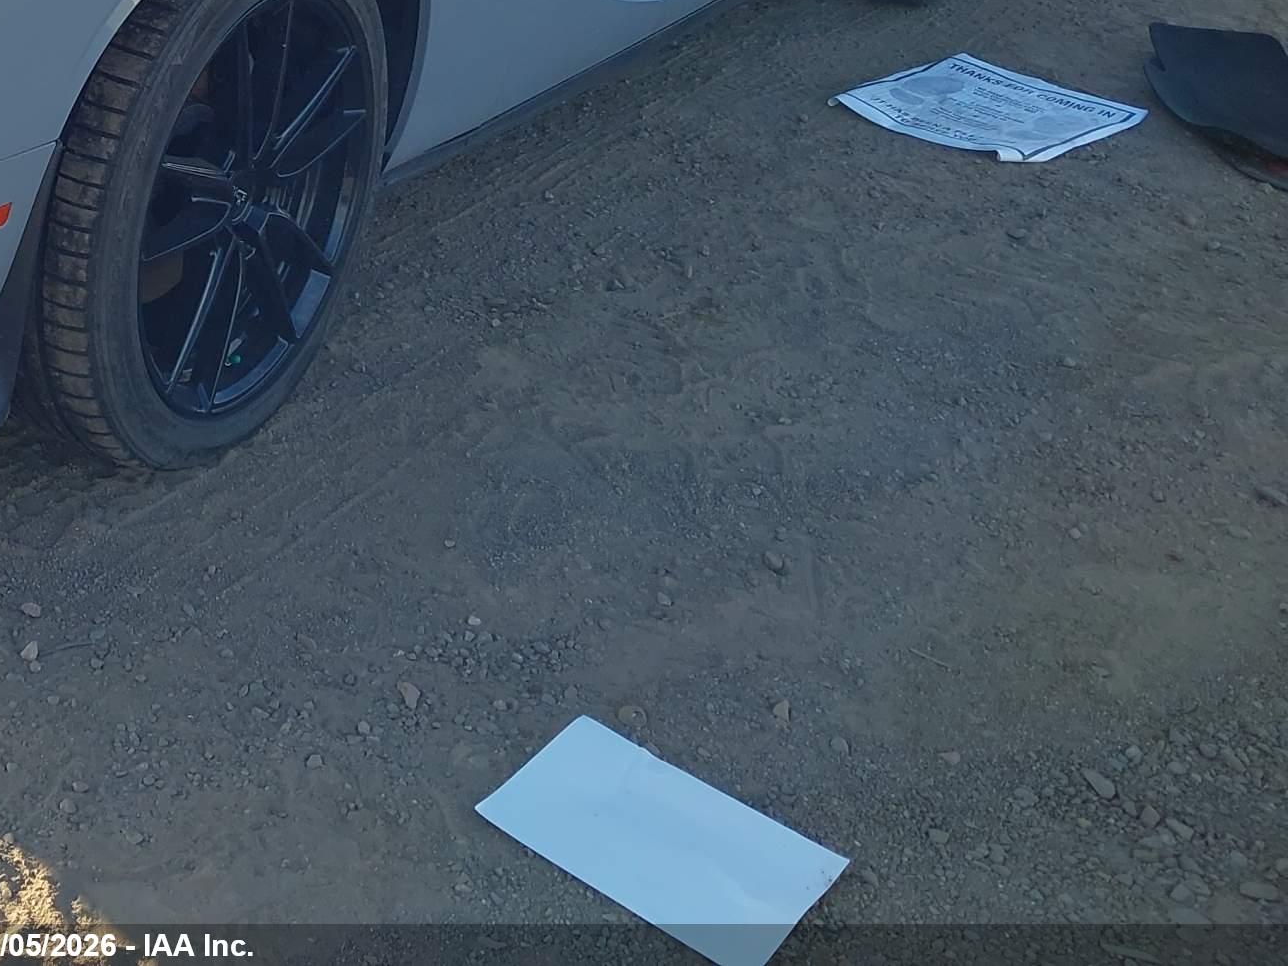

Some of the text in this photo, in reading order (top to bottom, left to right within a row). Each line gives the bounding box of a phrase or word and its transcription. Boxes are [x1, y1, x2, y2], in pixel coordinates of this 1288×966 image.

[950, 63, 1003, 85] THANKS
[1005, 83, 1035, 94] FOR
[1037, 93, 1095, 113] COMING
[1097, 108, 1117, 119] IN
